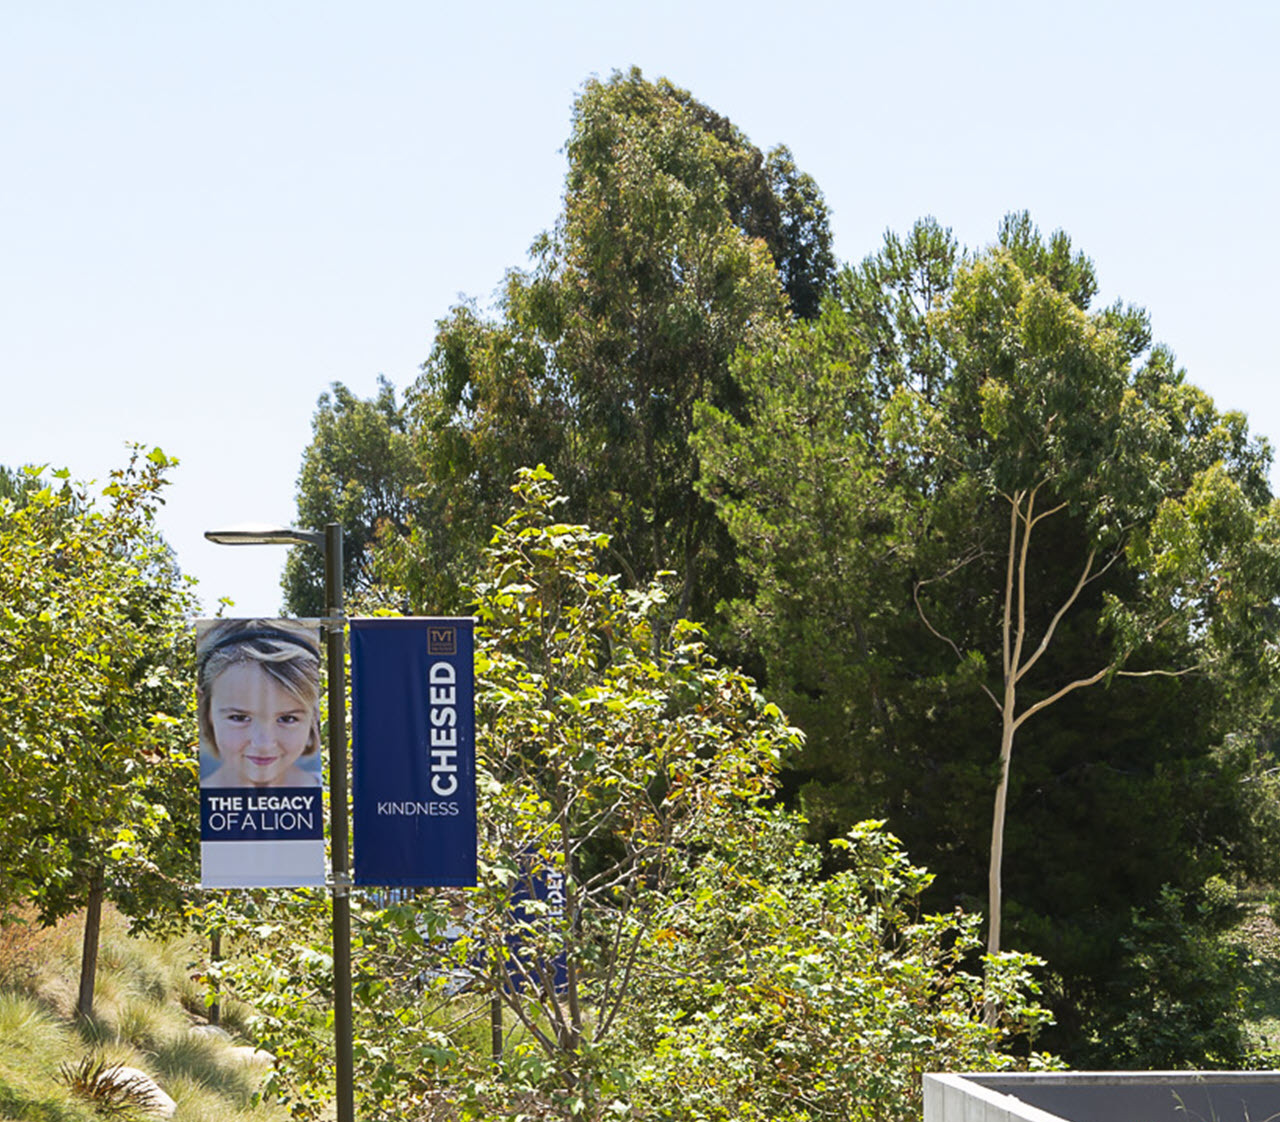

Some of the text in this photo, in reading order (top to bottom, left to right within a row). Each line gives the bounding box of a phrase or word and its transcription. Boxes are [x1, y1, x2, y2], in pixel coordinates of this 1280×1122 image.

[429, 661, 458, 796] CHESED
[208, 796, 314, 811] THE LEGACY
[377, 802, 459, 816] KINDNESS
[209, 812, 313, 831] OF A LION
